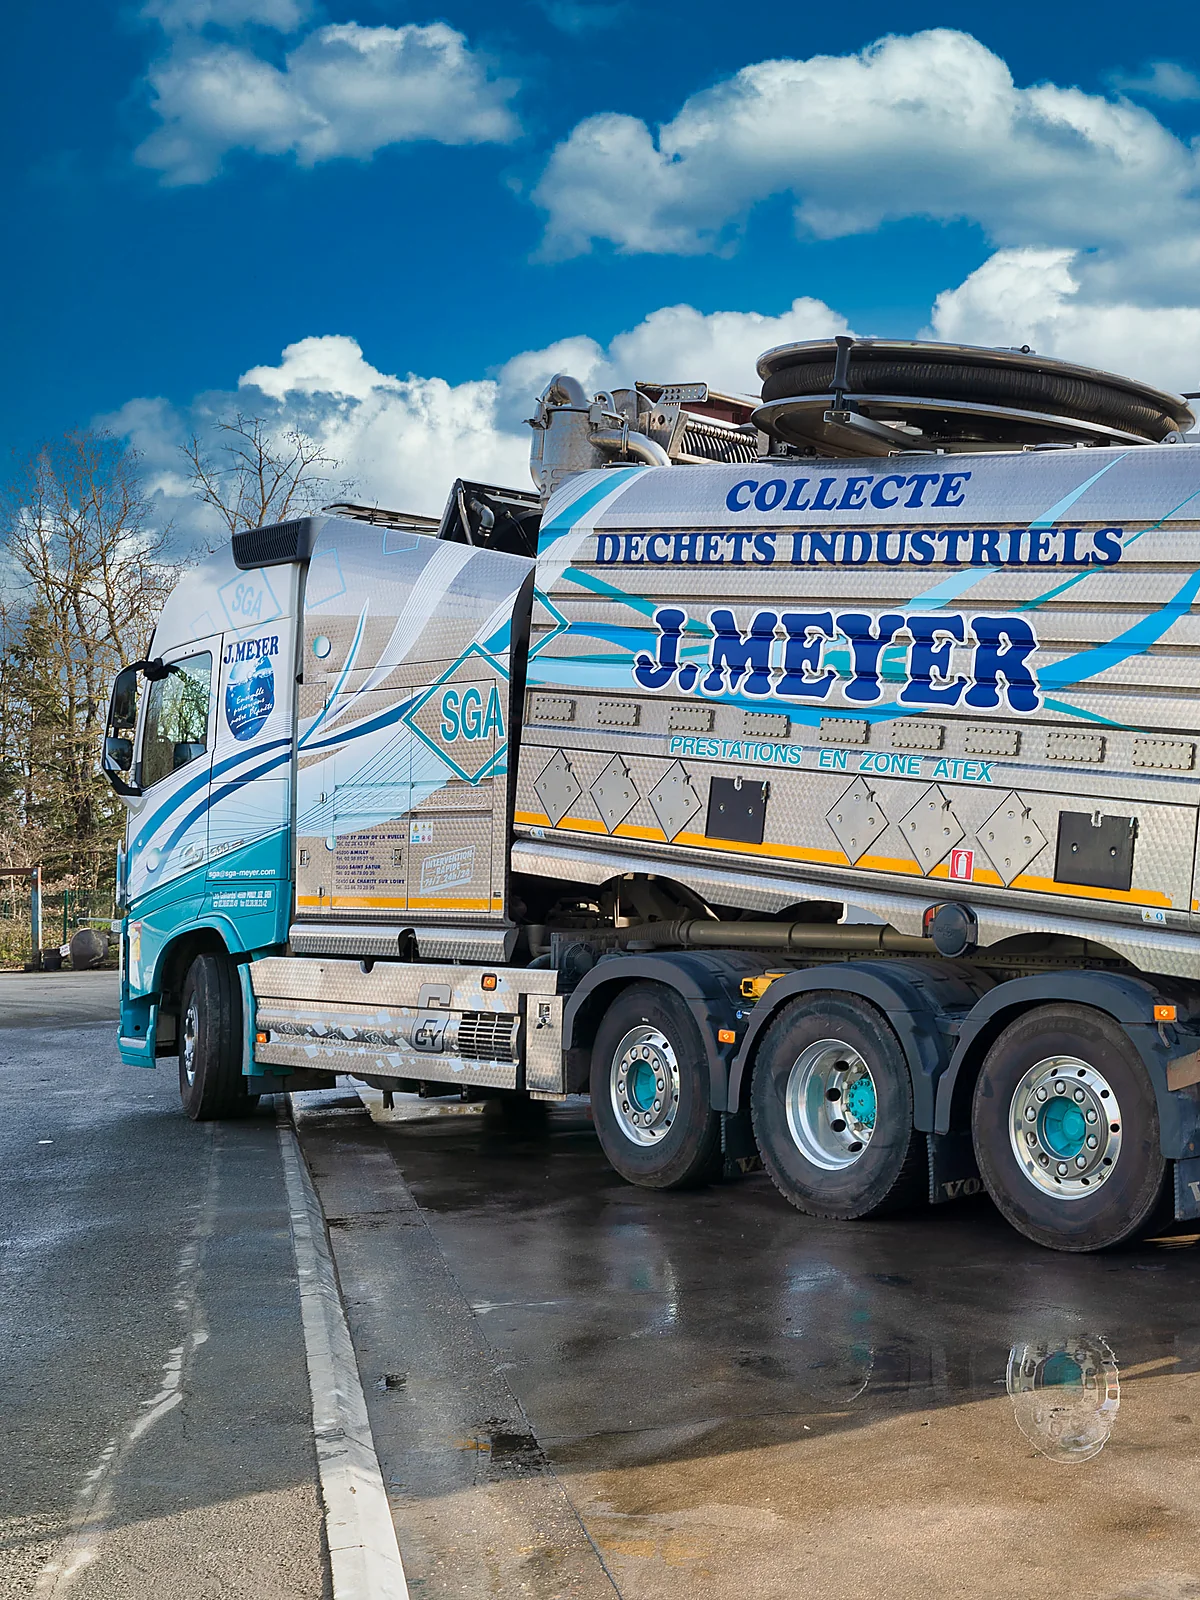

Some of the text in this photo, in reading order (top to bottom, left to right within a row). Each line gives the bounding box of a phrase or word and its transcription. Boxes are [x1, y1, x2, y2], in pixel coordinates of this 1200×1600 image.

[725, 471, 971, 513] COLLECTE
[595, 527, 1124, 567] DECHETS INDUSTRIELS
[231, 582, 264, 619] SGA
[223, 635, 279, 664] J.MEYER
[631, 604, 1044, 715] J.MEYER
[236, 687, 264, 705] Ensemble
[230, 713, 247, 726] notre
[440, 686, 505, 742] SGA
[669, 735, 998, 783] PRESTATIONS EN ZONE ATEX
[208, 869, 276, 879] sga@sga-meyer.com
[425, 849, 473, 870] INTERVENTION
[436, 861, 461, 875] RAPIDE
[414, 1028, 442, 1047] CY
